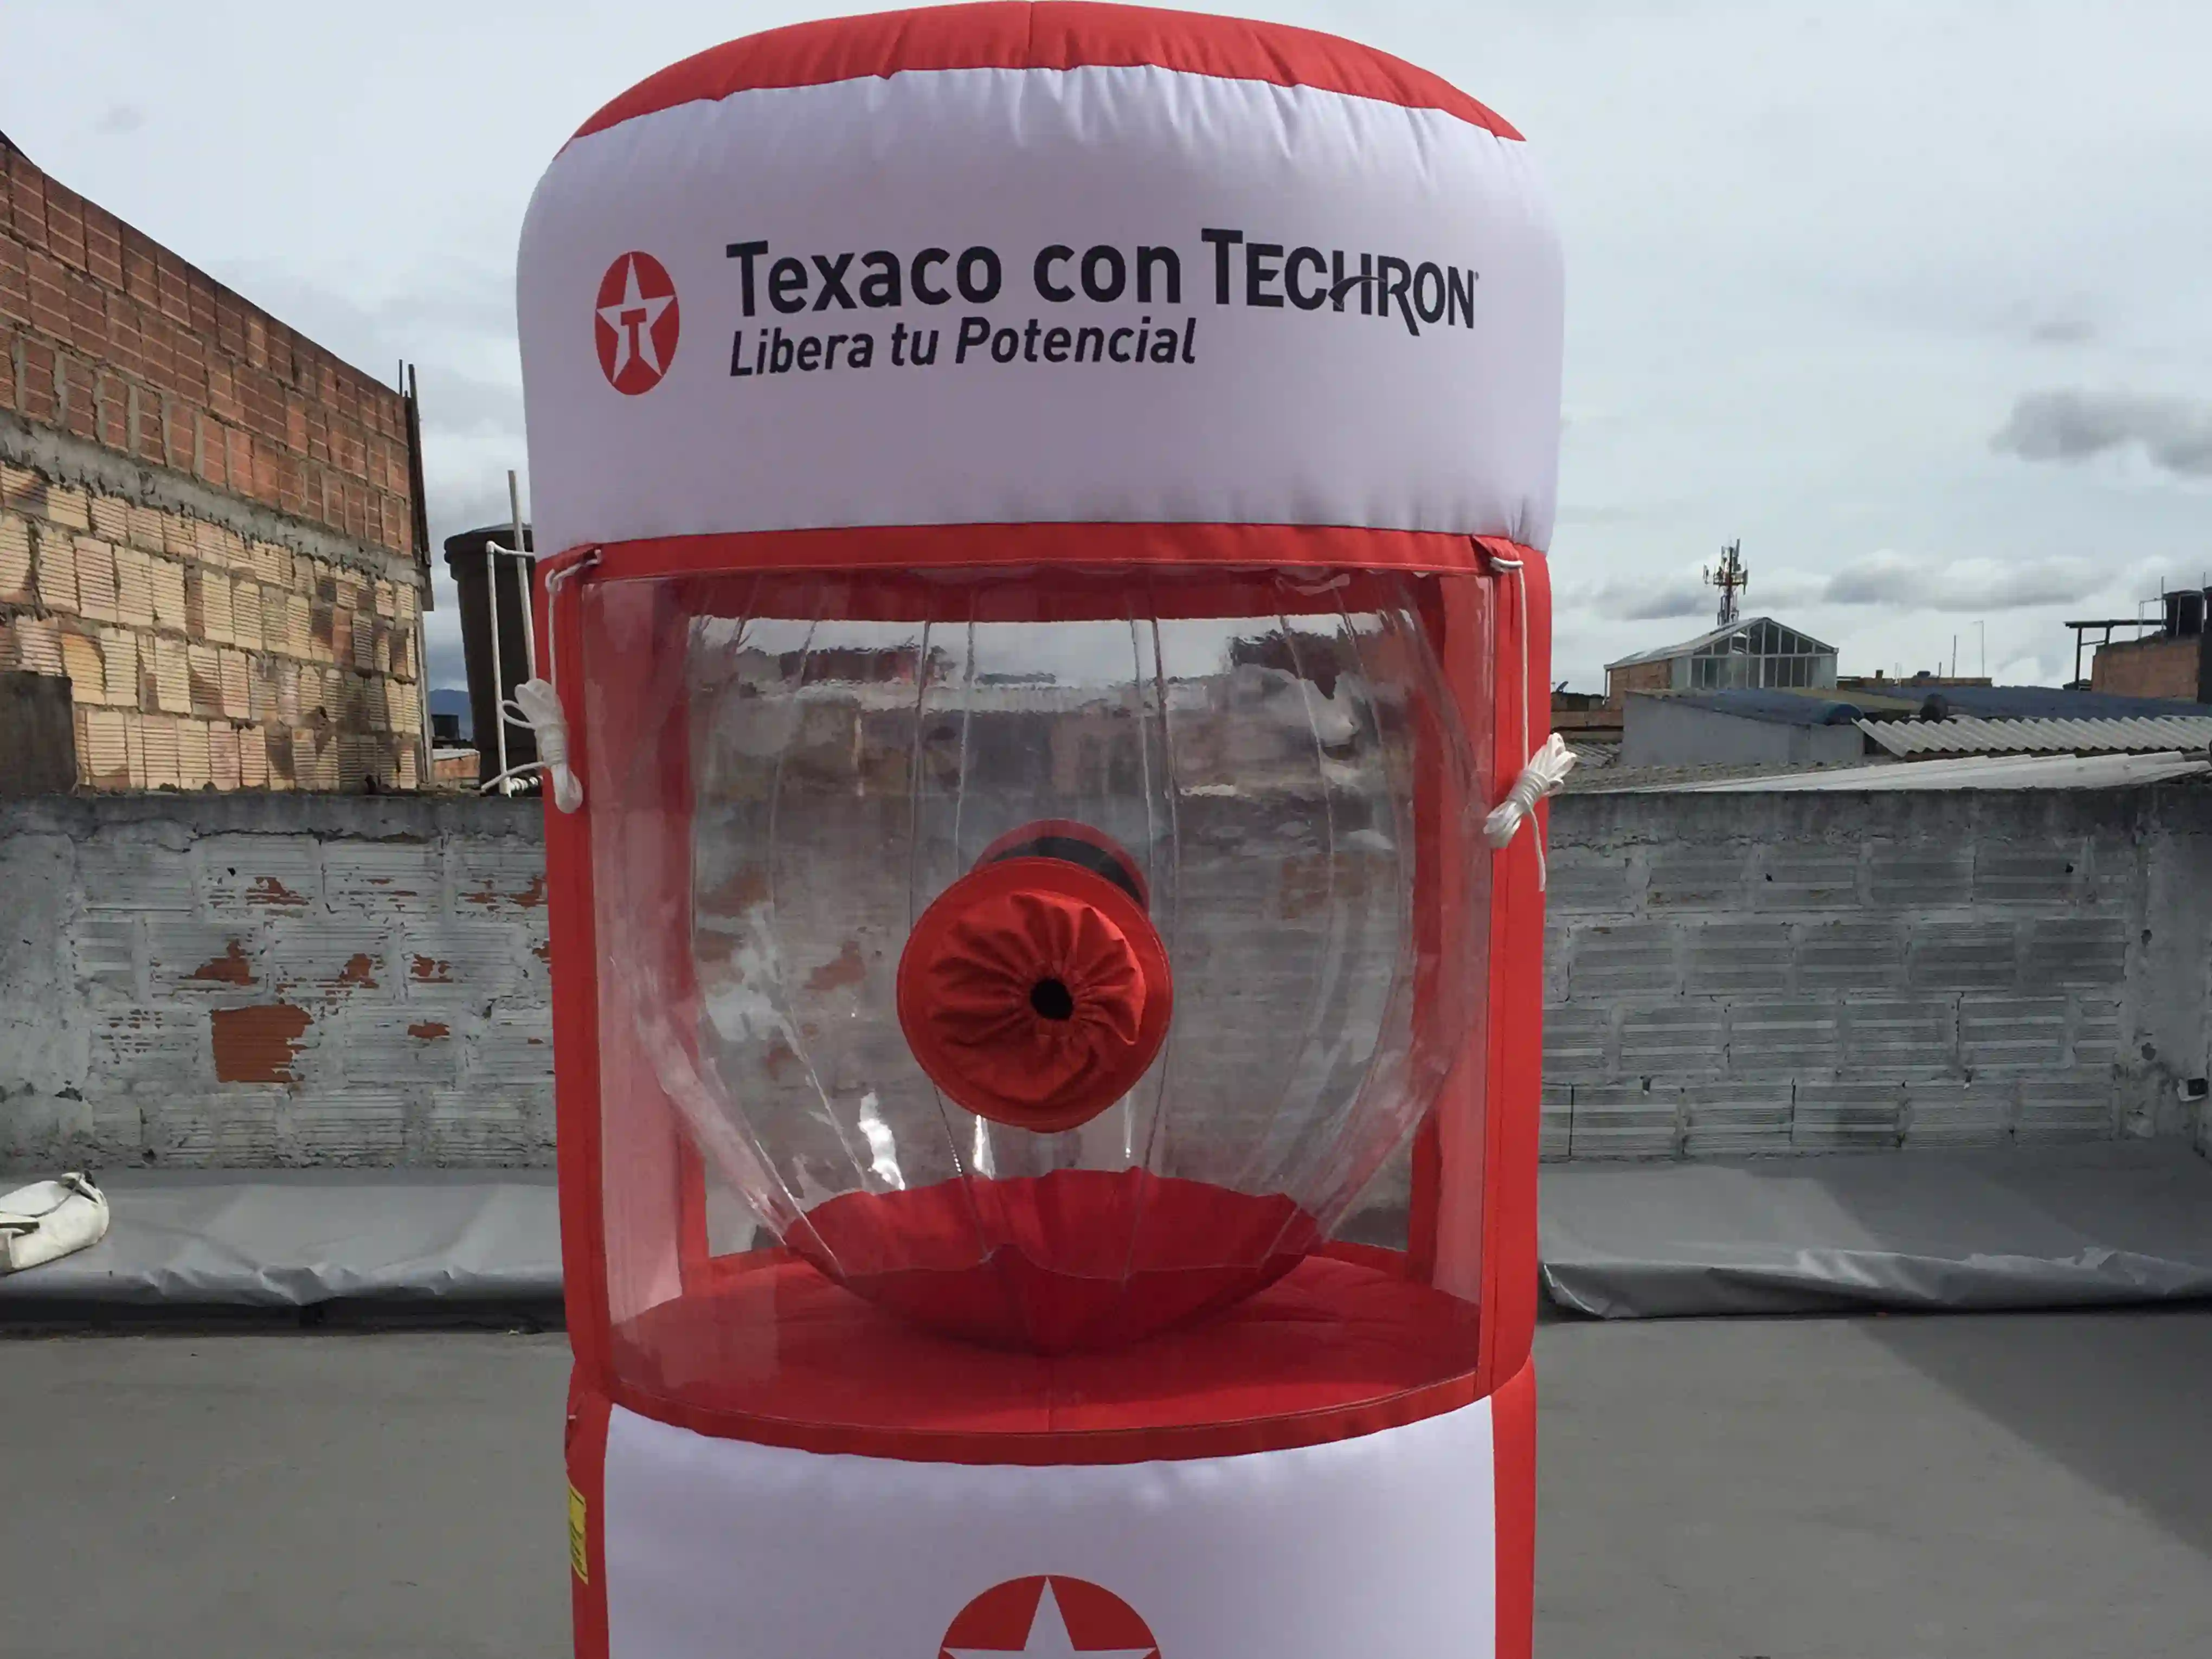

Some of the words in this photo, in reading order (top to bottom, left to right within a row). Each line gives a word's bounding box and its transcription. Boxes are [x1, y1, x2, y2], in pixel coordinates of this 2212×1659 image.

[725, 239, 1002, 318] Texaco
[1033, 243, 1181, 305] con
[729, 326, 874, 377] Libera
[890, 321, 940, 367] tu
[954, 315, 1197, 365] Potencial
